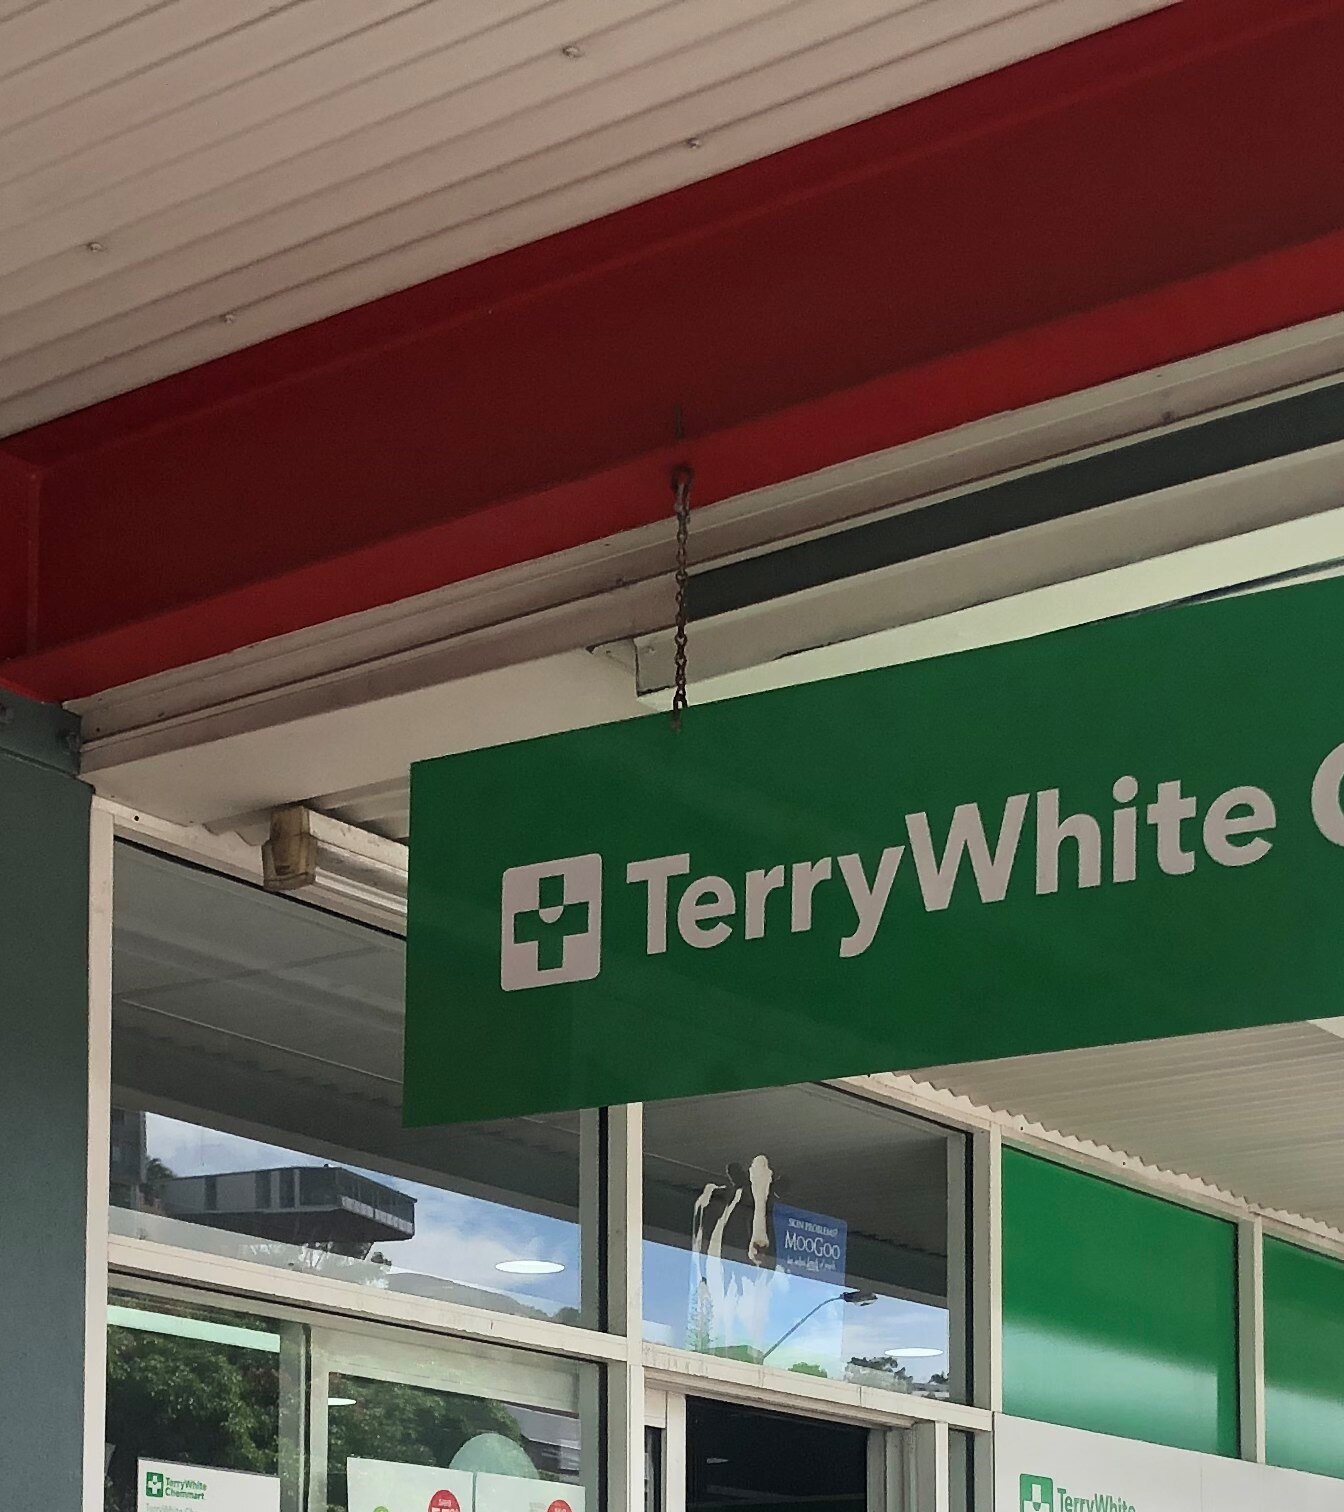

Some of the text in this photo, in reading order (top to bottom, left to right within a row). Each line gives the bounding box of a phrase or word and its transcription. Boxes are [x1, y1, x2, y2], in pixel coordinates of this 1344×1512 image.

[625, 774, 1278, 960] TerryWhite
[165, 1477, 207, 1490] TerryWhite
[165, 1487, 204, 1499] Chemmart
